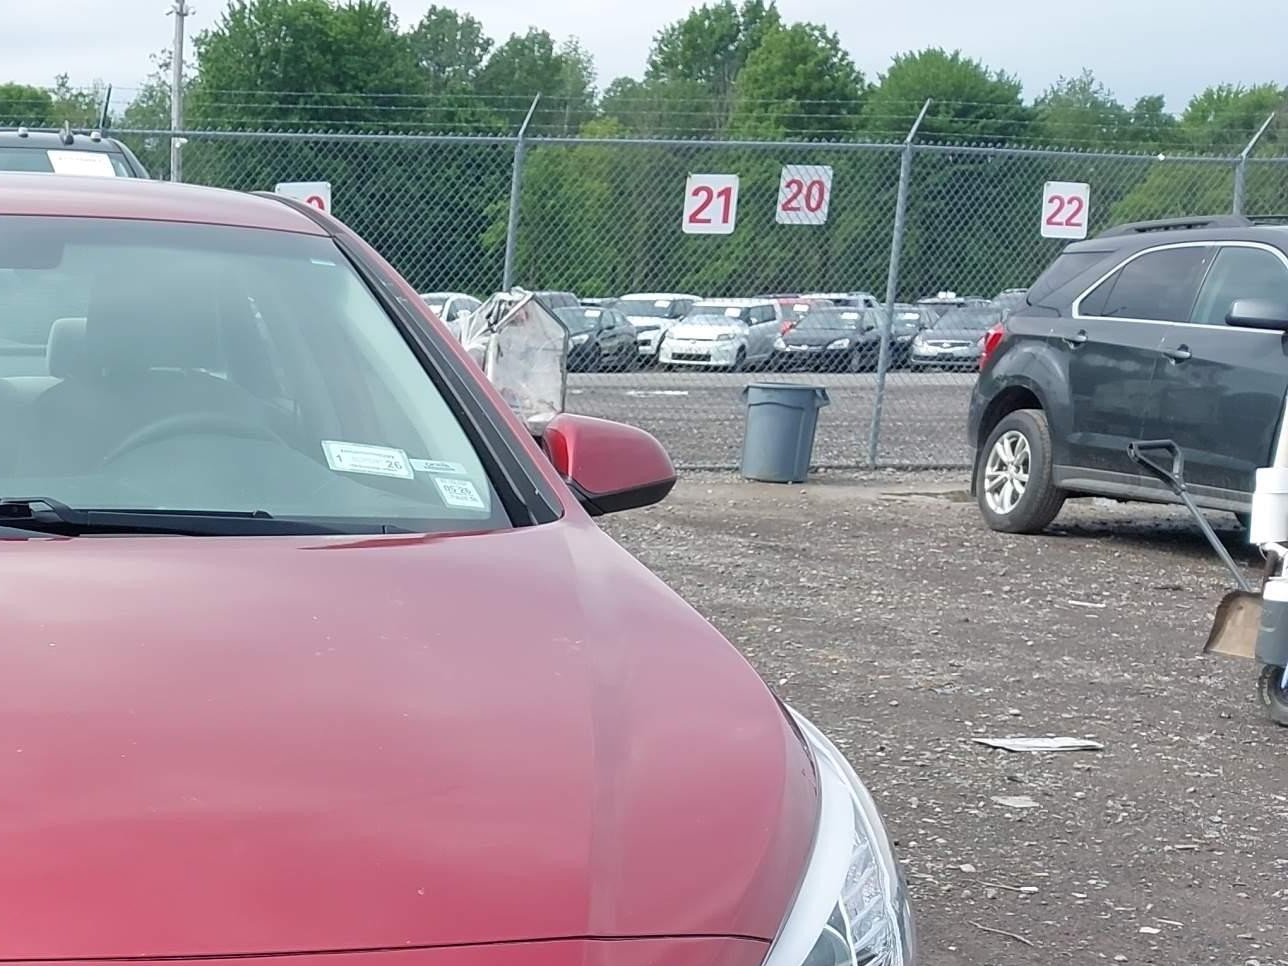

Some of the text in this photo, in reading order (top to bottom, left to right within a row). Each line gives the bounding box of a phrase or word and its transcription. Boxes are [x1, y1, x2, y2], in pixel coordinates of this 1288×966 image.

[688, 185, 732, 224] 21
[781, 178, 825, 213] 20
[1046, 194, 1084, 227] 22
